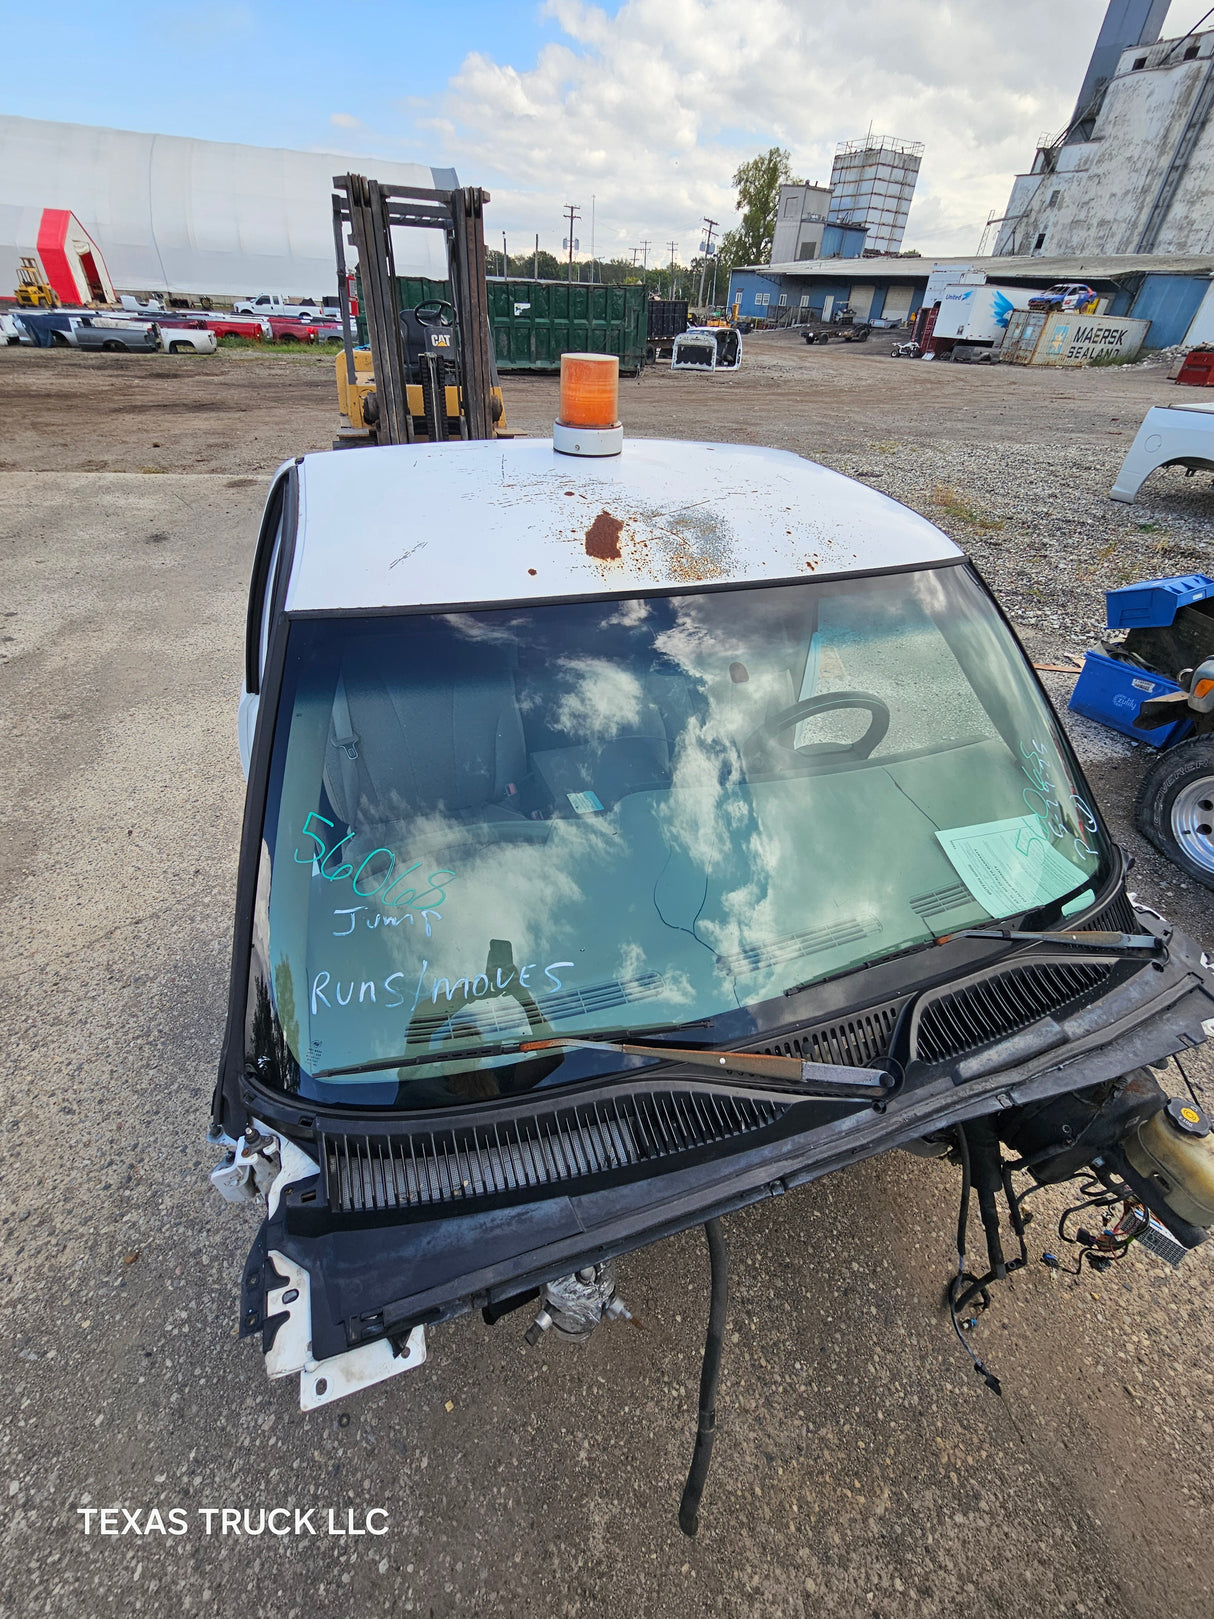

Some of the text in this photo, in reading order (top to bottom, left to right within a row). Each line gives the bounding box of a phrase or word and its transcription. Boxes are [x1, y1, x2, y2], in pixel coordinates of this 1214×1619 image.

[431, 334, 451, 347] CAT
[1073, 326, 1128, 346] MAERSK
[294, 811, 456, 910] 56068
